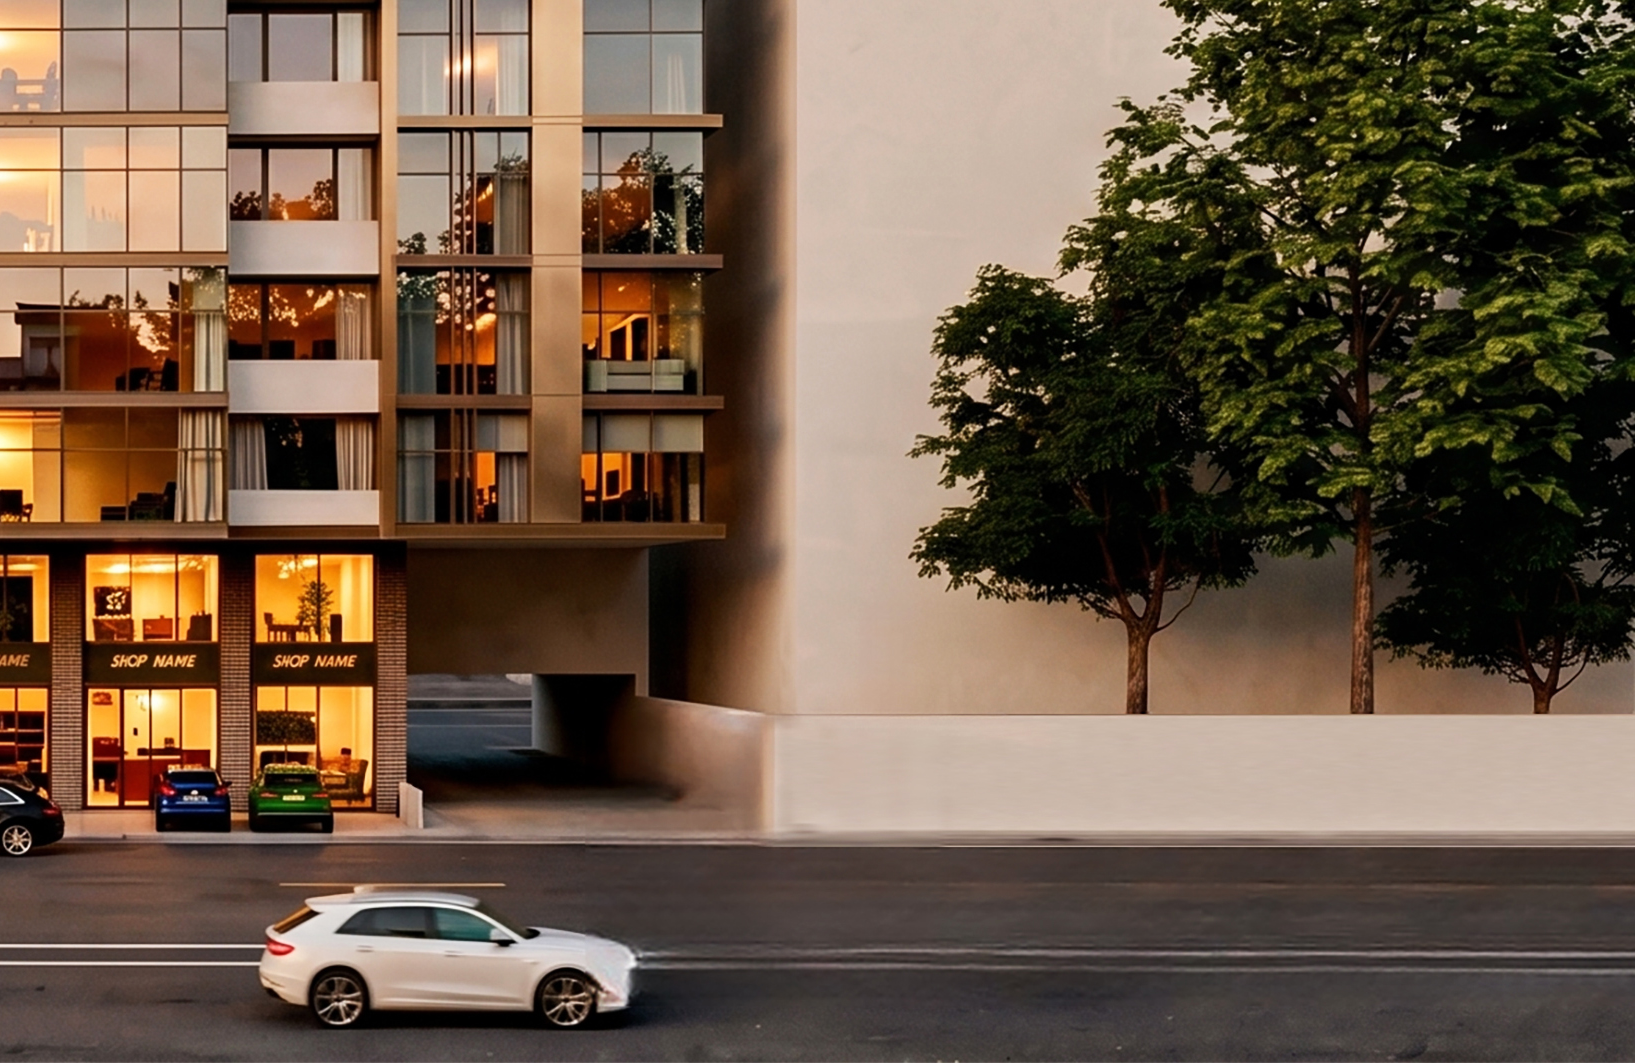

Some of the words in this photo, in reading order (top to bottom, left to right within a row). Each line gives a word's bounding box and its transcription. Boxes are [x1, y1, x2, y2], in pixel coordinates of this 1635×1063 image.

[111, 654, 148, 668] SHOP
[153, 654, 196, 667] NAME
[273, 654, 310, 668] SHOP
[314, 654, 357, 667] NAME
